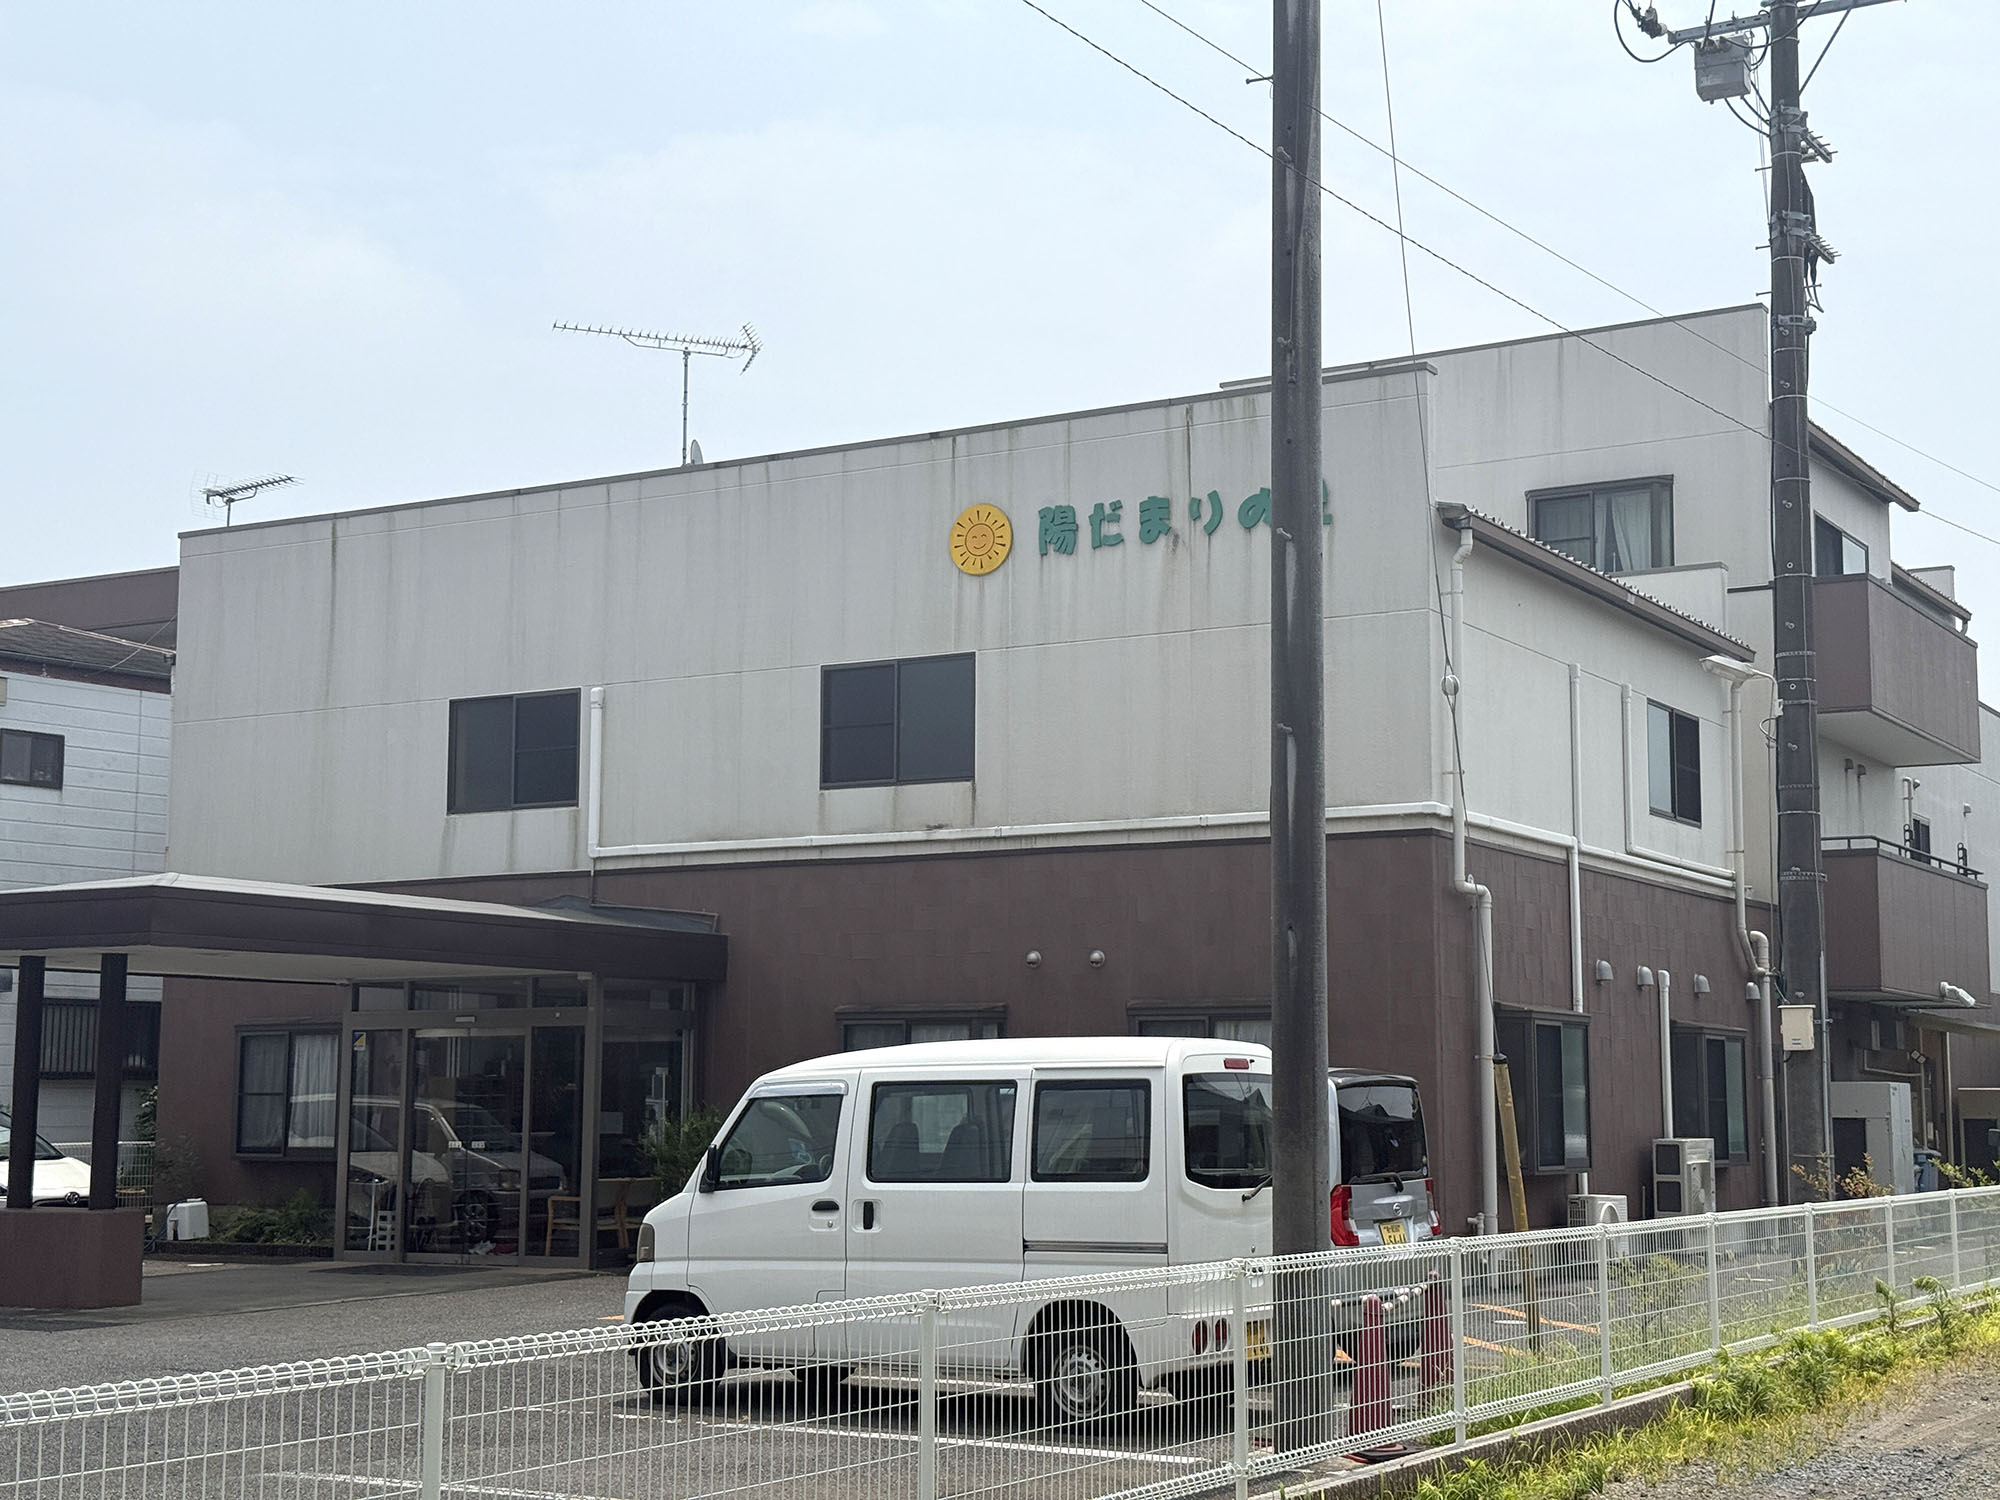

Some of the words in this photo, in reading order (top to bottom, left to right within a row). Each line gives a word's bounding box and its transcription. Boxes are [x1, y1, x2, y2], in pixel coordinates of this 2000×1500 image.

[1038, 479, 1333, 555] 陽だまりの
